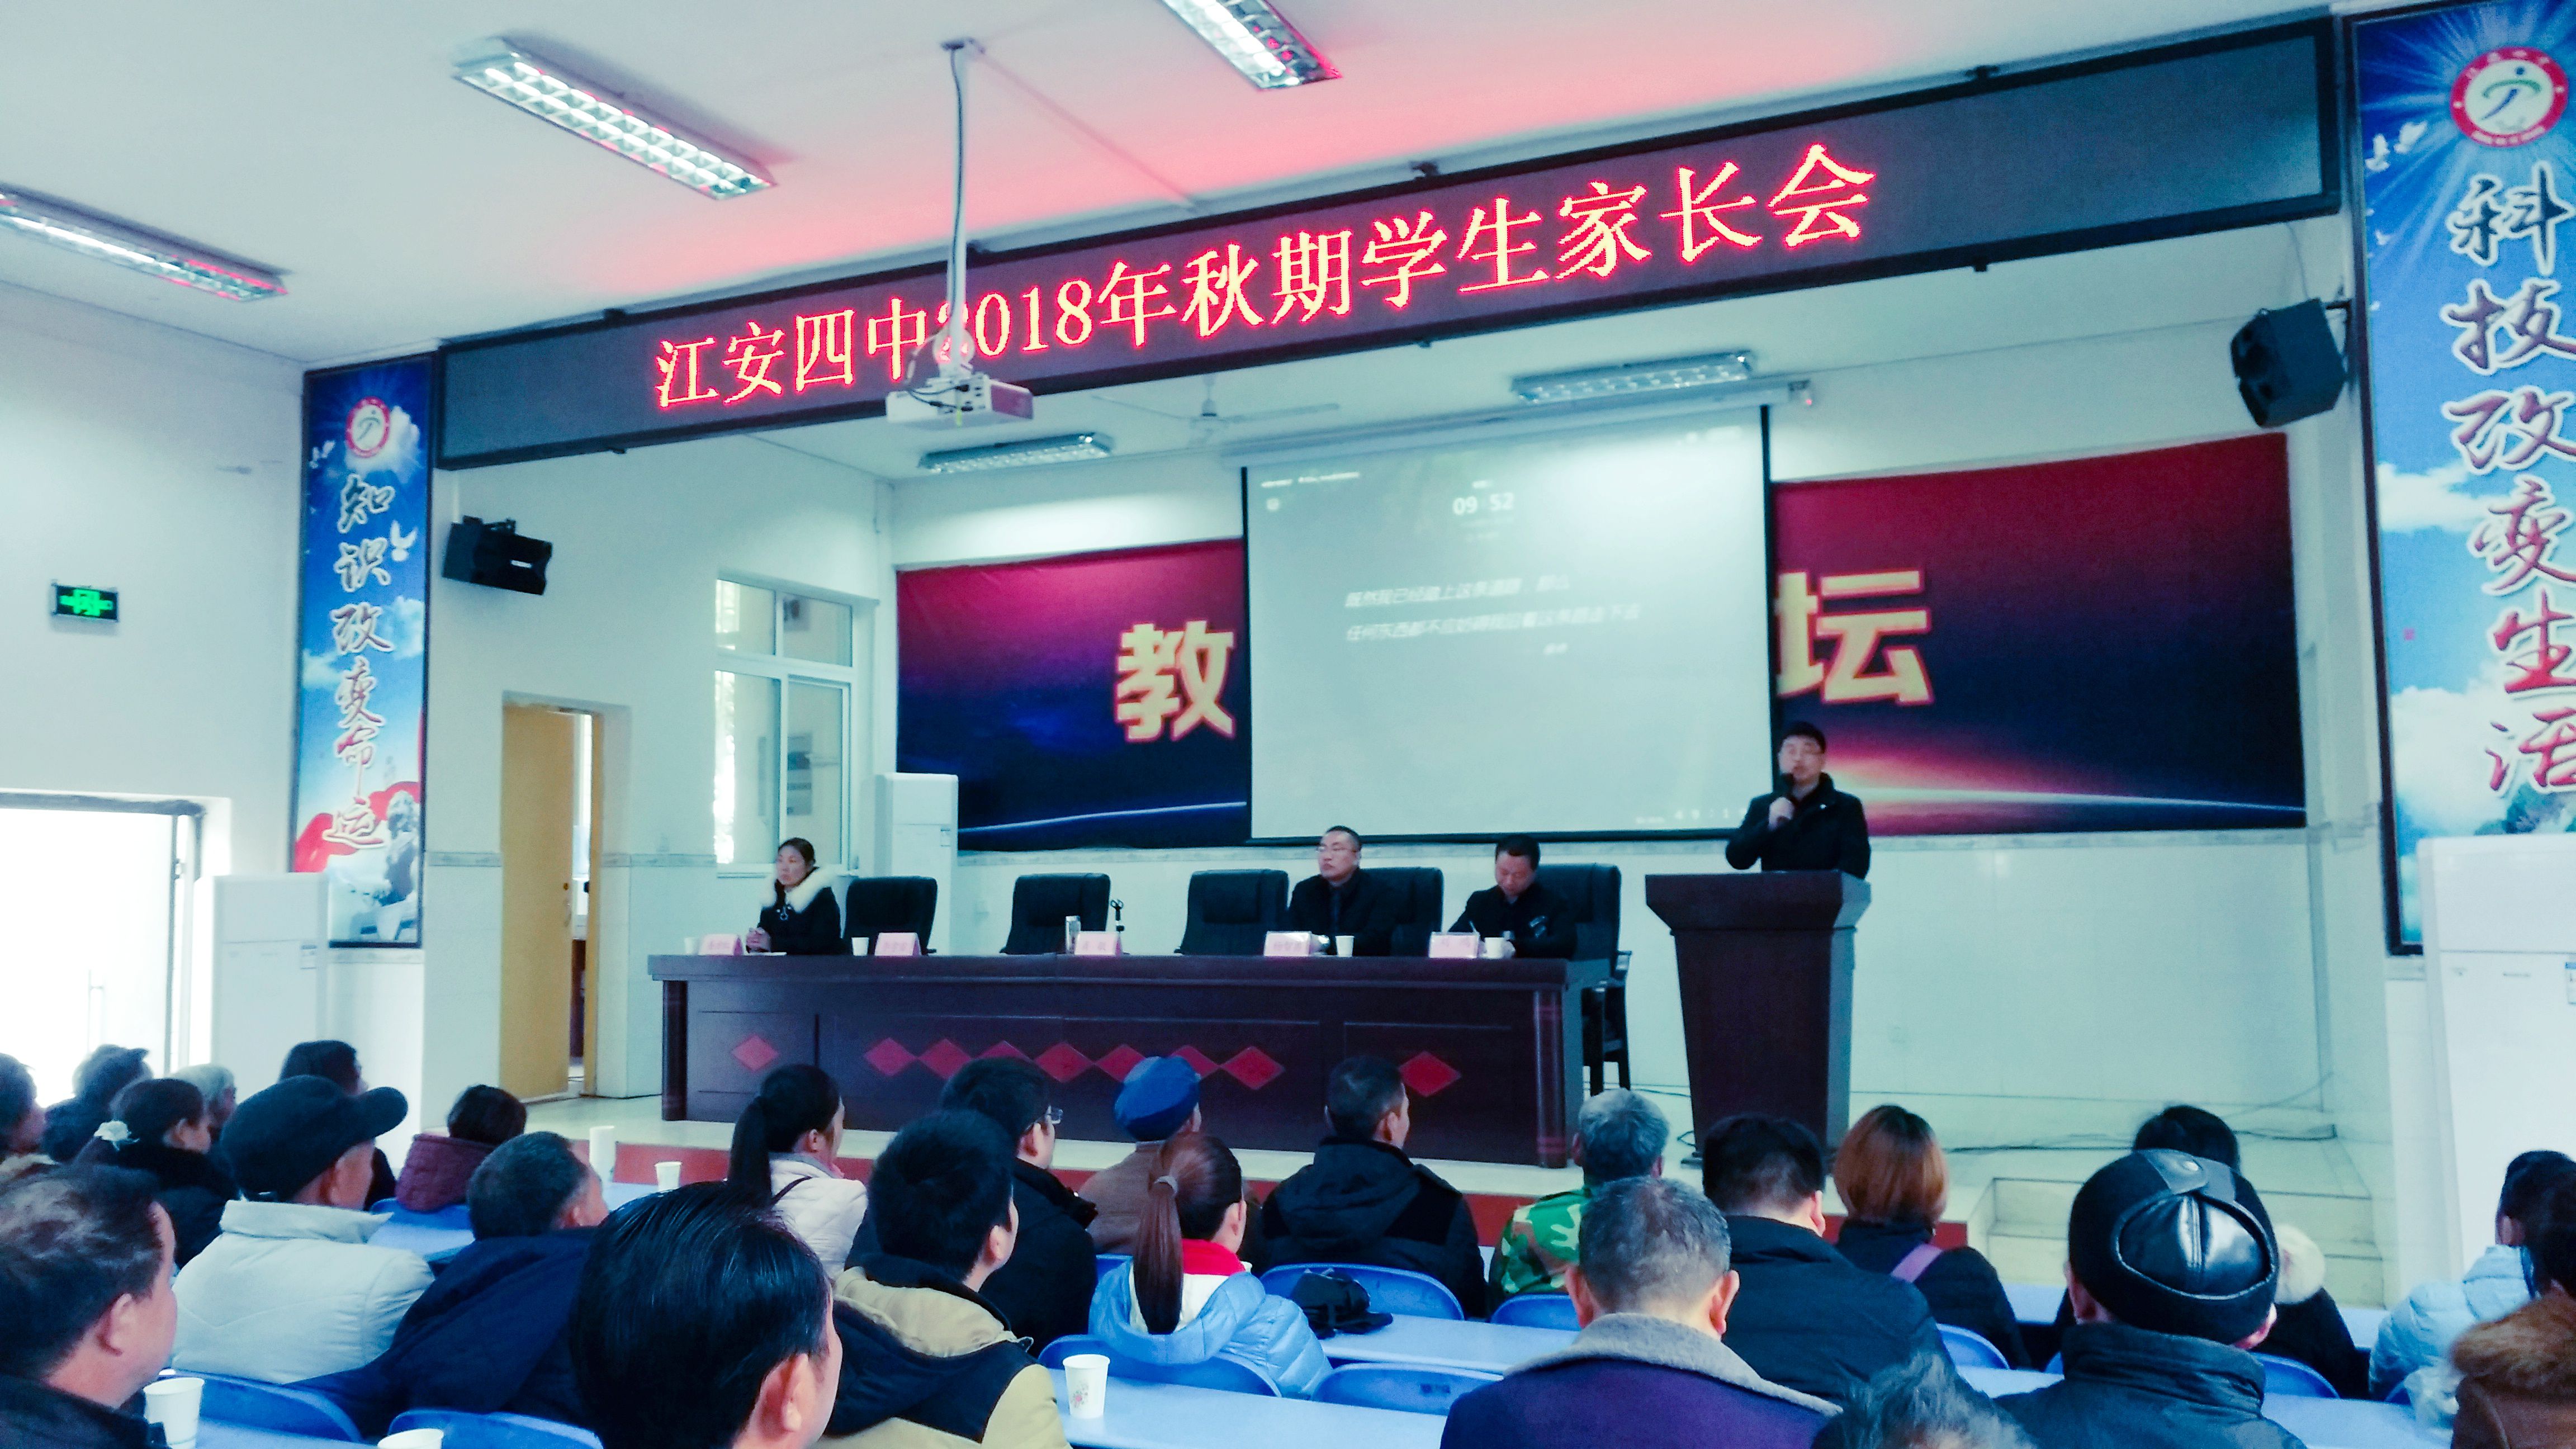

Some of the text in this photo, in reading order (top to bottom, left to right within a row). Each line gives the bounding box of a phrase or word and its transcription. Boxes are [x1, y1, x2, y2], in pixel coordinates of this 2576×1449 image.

[654, 143, 1877, 411] 江安四中2018年秋期学生家长会
[2441, 161, 2576, 794] 科技改变生活
[323, 473, 395, 849] 知识改变命运
[1115, 568, 1933, 741] 教 坛
